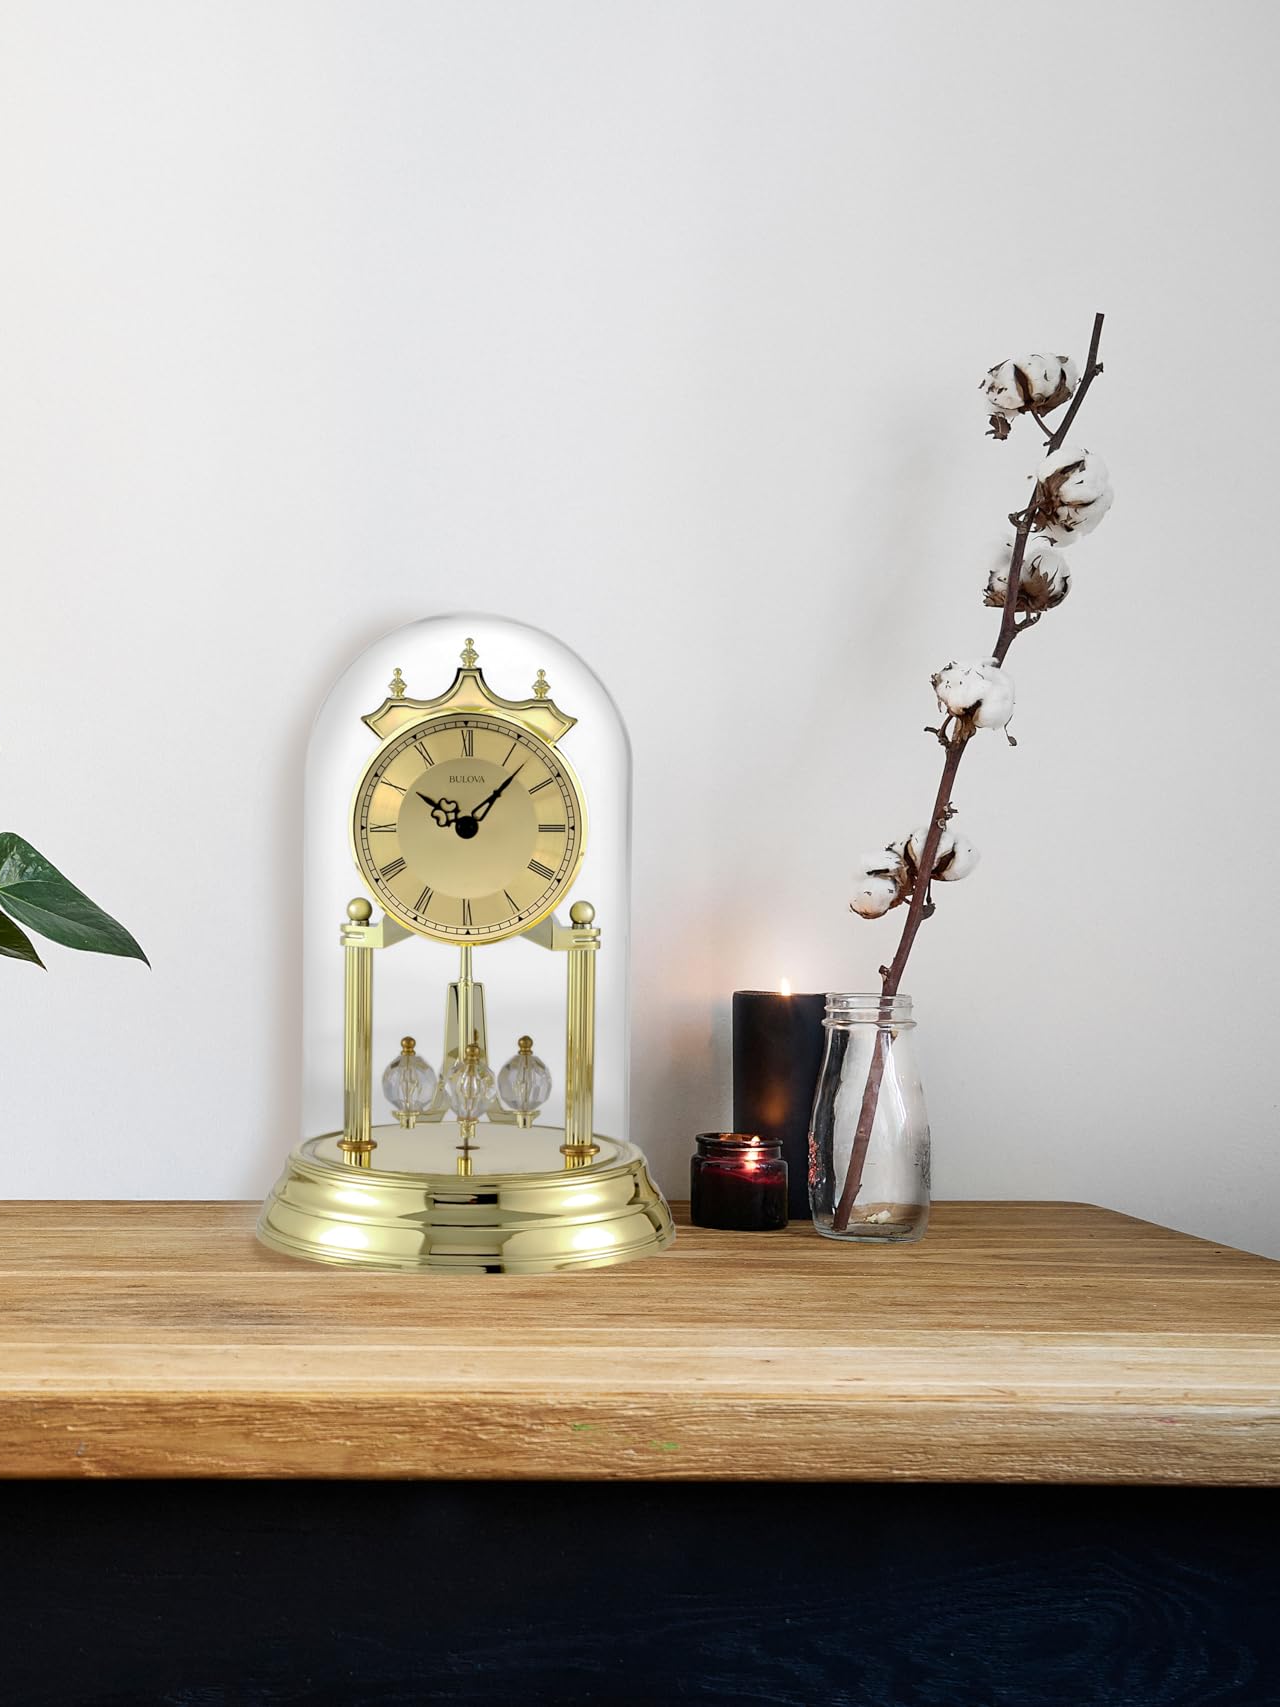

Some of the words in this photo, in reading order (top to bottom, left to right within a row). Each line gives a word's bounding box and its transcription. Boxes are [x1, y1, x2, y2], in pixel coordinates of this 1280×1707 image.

[460, 729, 474, 757] XII
[413, 741, 435, 769] XI
[380, 776, 407, 796] X
[449, 775, 485, 784] BULOVA
[528, 777, 554, 795] II
[369, 822, 397, 833] IX
[538, 823, 566, 833] III
[379, 857, 408, 882] VIII
[527, 858, 556, 881] IIII
[413, 886, 434, 914] VII
[462, 898, 473, 926] VI
